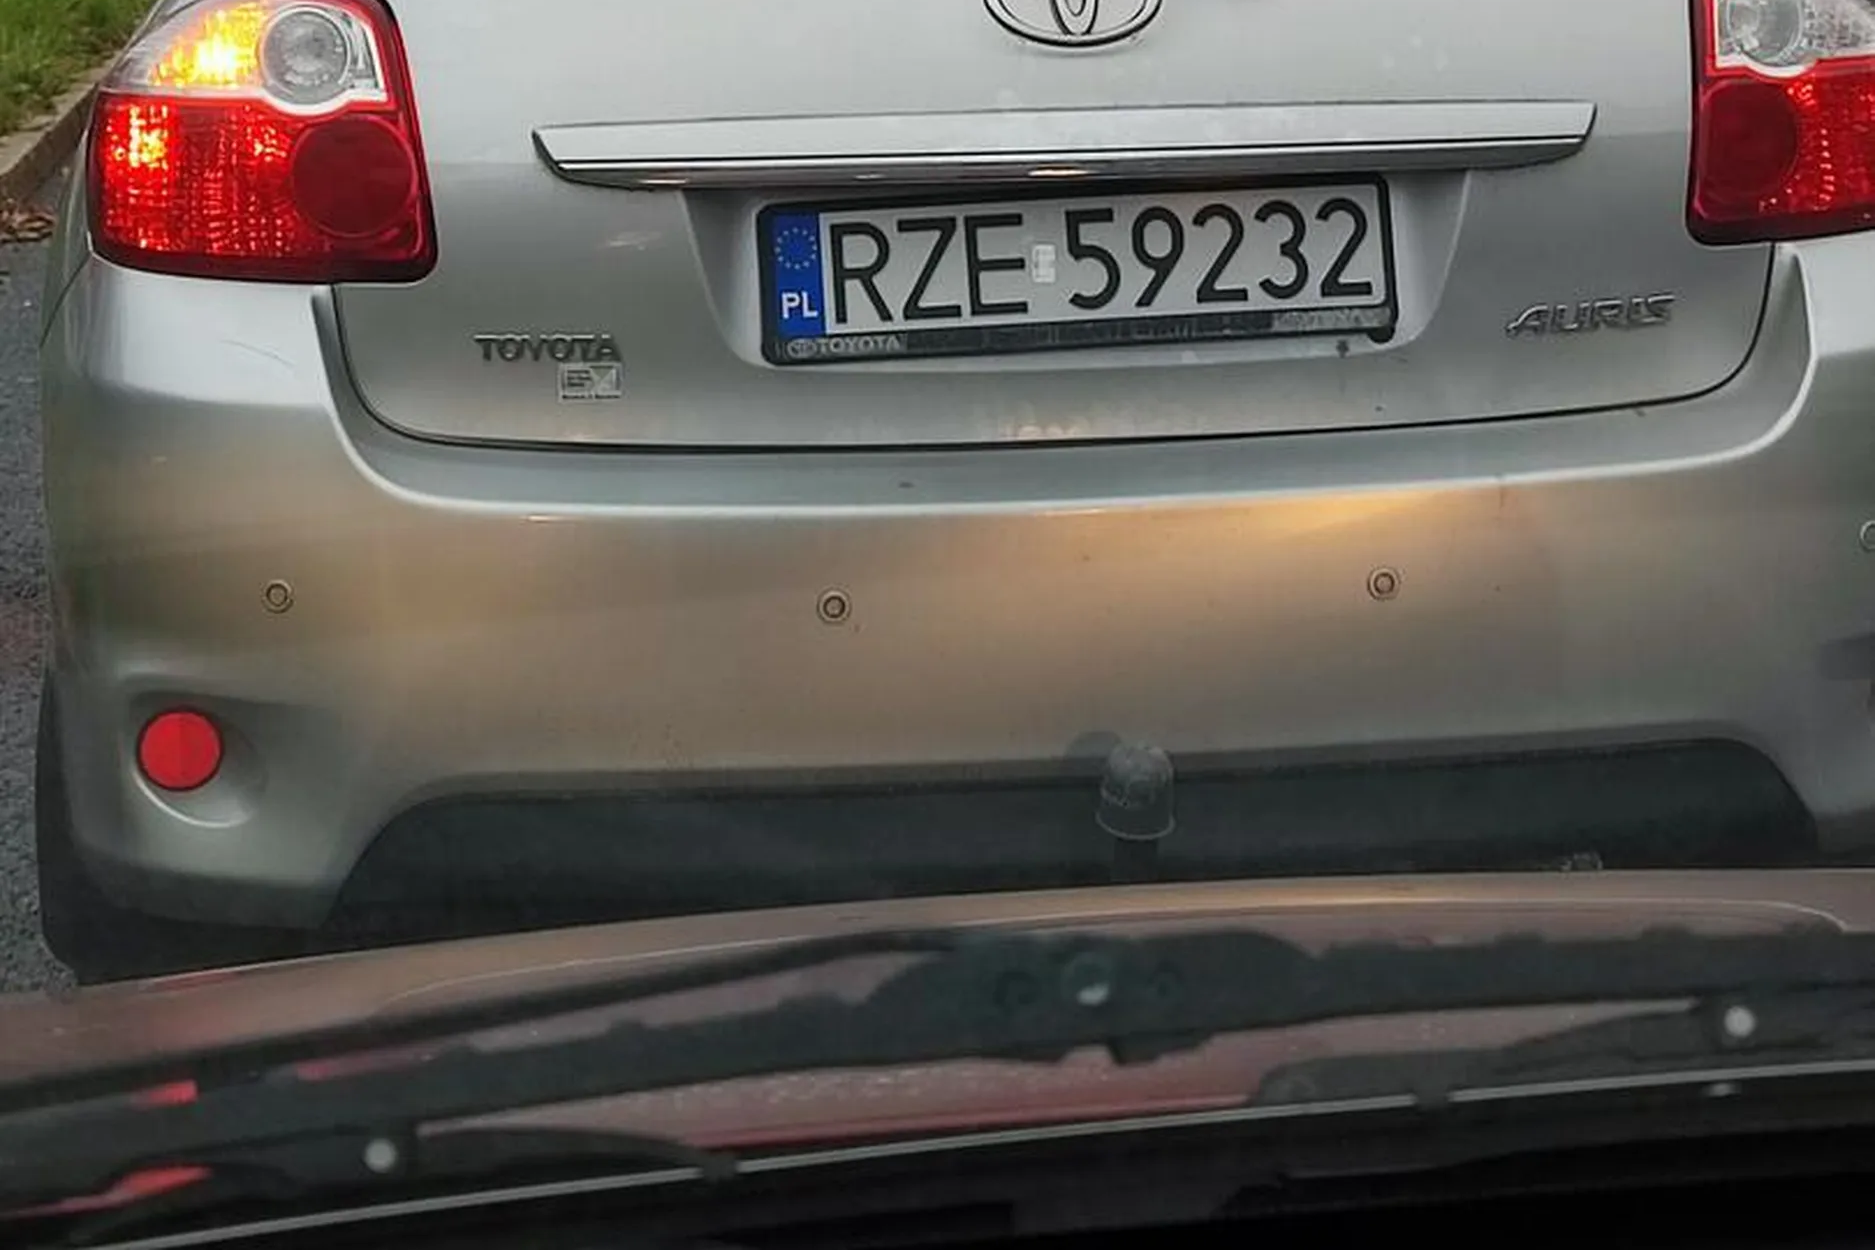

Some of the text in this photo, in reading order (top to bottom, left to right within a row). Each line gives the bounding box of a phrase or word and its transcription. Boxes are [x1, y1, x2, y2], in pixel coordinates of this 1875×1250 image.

[829, 197, 1374, 325] RZE 59232
[781, 291, 818, 319] PL
[1505, 292, 1677, 336] AURIS
[474, 334, 622, 362] TOYOTA
[818, 335, 900, 357] TOYOTA
